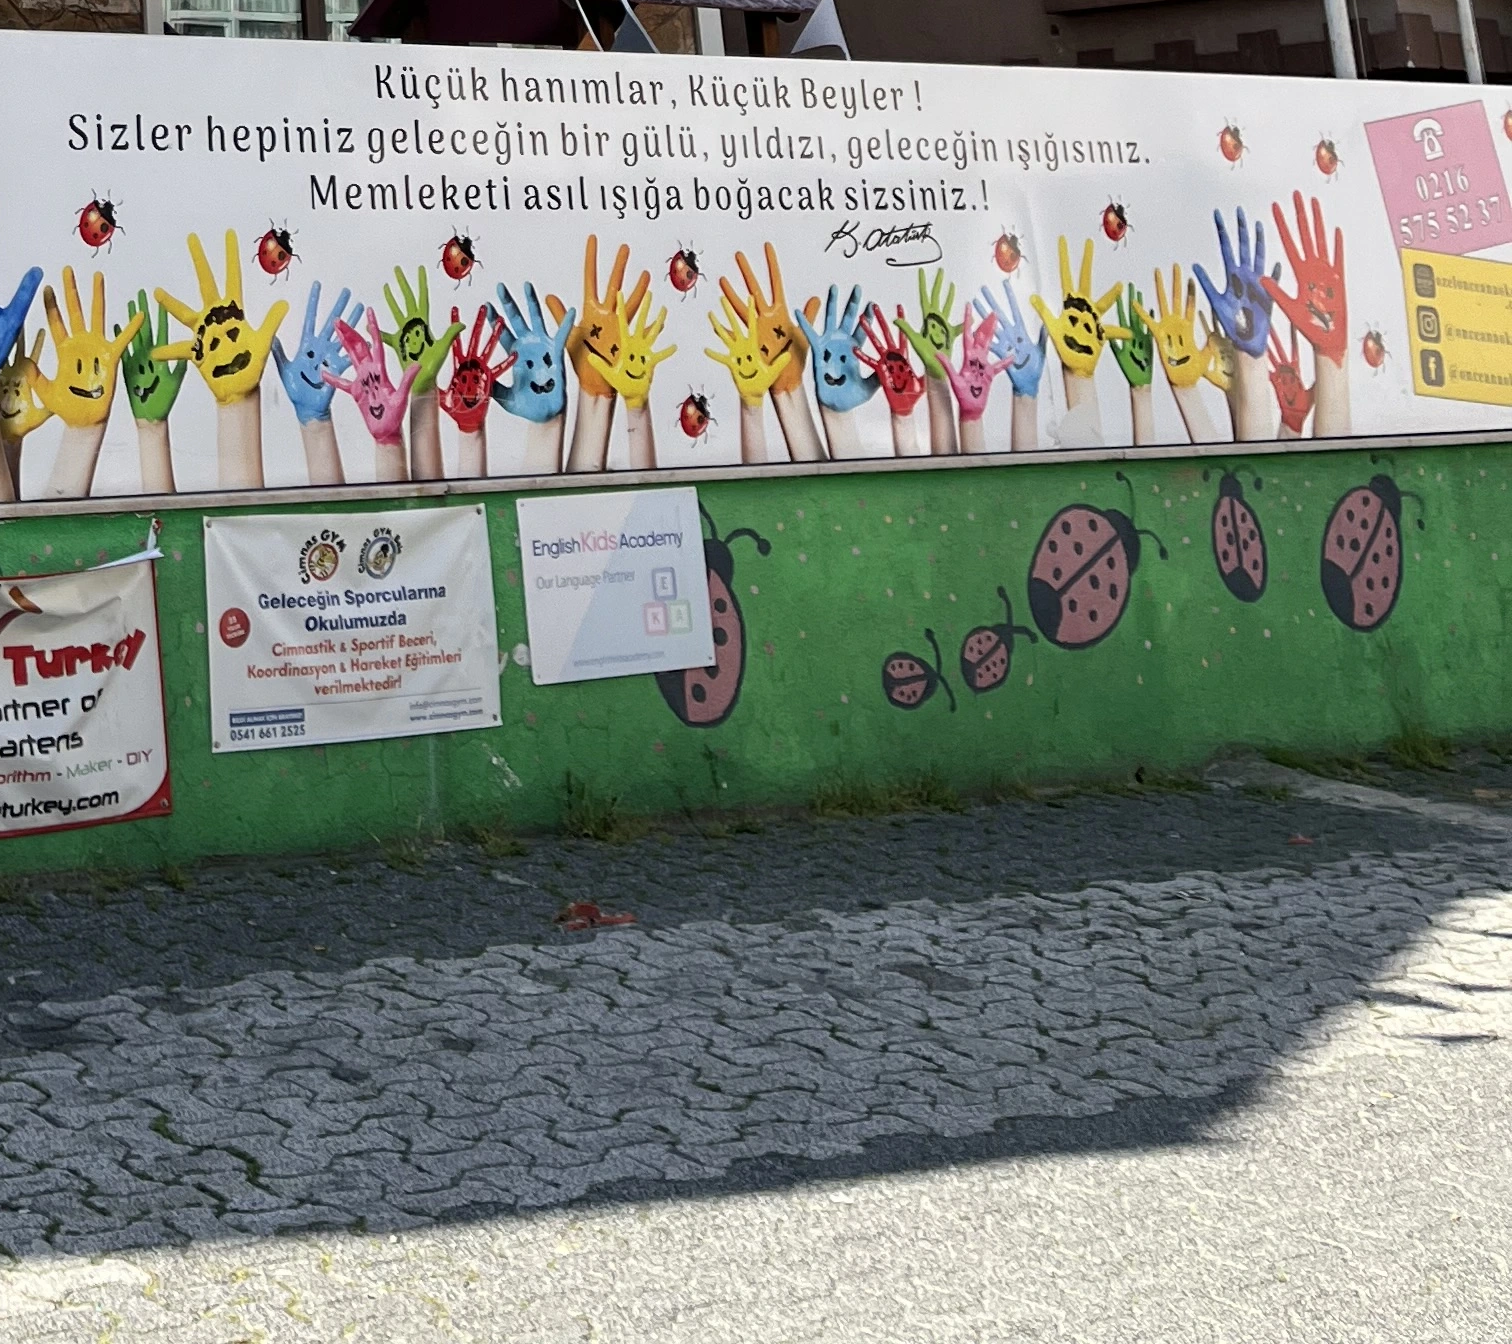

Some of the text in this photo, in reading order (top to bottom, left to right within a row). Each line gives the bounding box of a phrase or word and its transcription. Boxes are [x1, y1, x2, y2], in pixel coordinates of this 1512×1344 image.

[376, 64, 489, 110] Küçük
[501, 67, 677, 111] hanımlar,
[690, 76, 791, 116] Küçük
[68, 114, 1151, 172] Sizler hepiniz geleceğin bir gülü, yıldızı, geleceğin ışığısınız.
[309, 173, 511, 211] Memleketi
[522, 178, 587, 211] asıl
[599, 177, 684, 220] ışığa
[693, 177, 834, 220] boğacak
[1415, 165, 1470, 203] 0216
[1400, 195, 1502, 246] 575 52 37
[536, 574, 554, 591] Our
[555, 571, 601, 589] Language
[258, 585, 447, 611] Geleceğin Sporcularına
[304, 611, 408, 633] Okulumuzda
[3, 628, 147, 688] Turkey
[272, 638, 336, 658] Cimnastik
[351, 634, 396, 658] Sportif
[247, 663, 337, 680] Koordinasyon
[351, 656, 402, 674] Hareket
[405, 648, 462, 671] Eğitimleri
[314, 675, 402, 696] verilmektedir!
[66, 758, 113, 780] Maker
[126, 748, 154, 767] DIY
